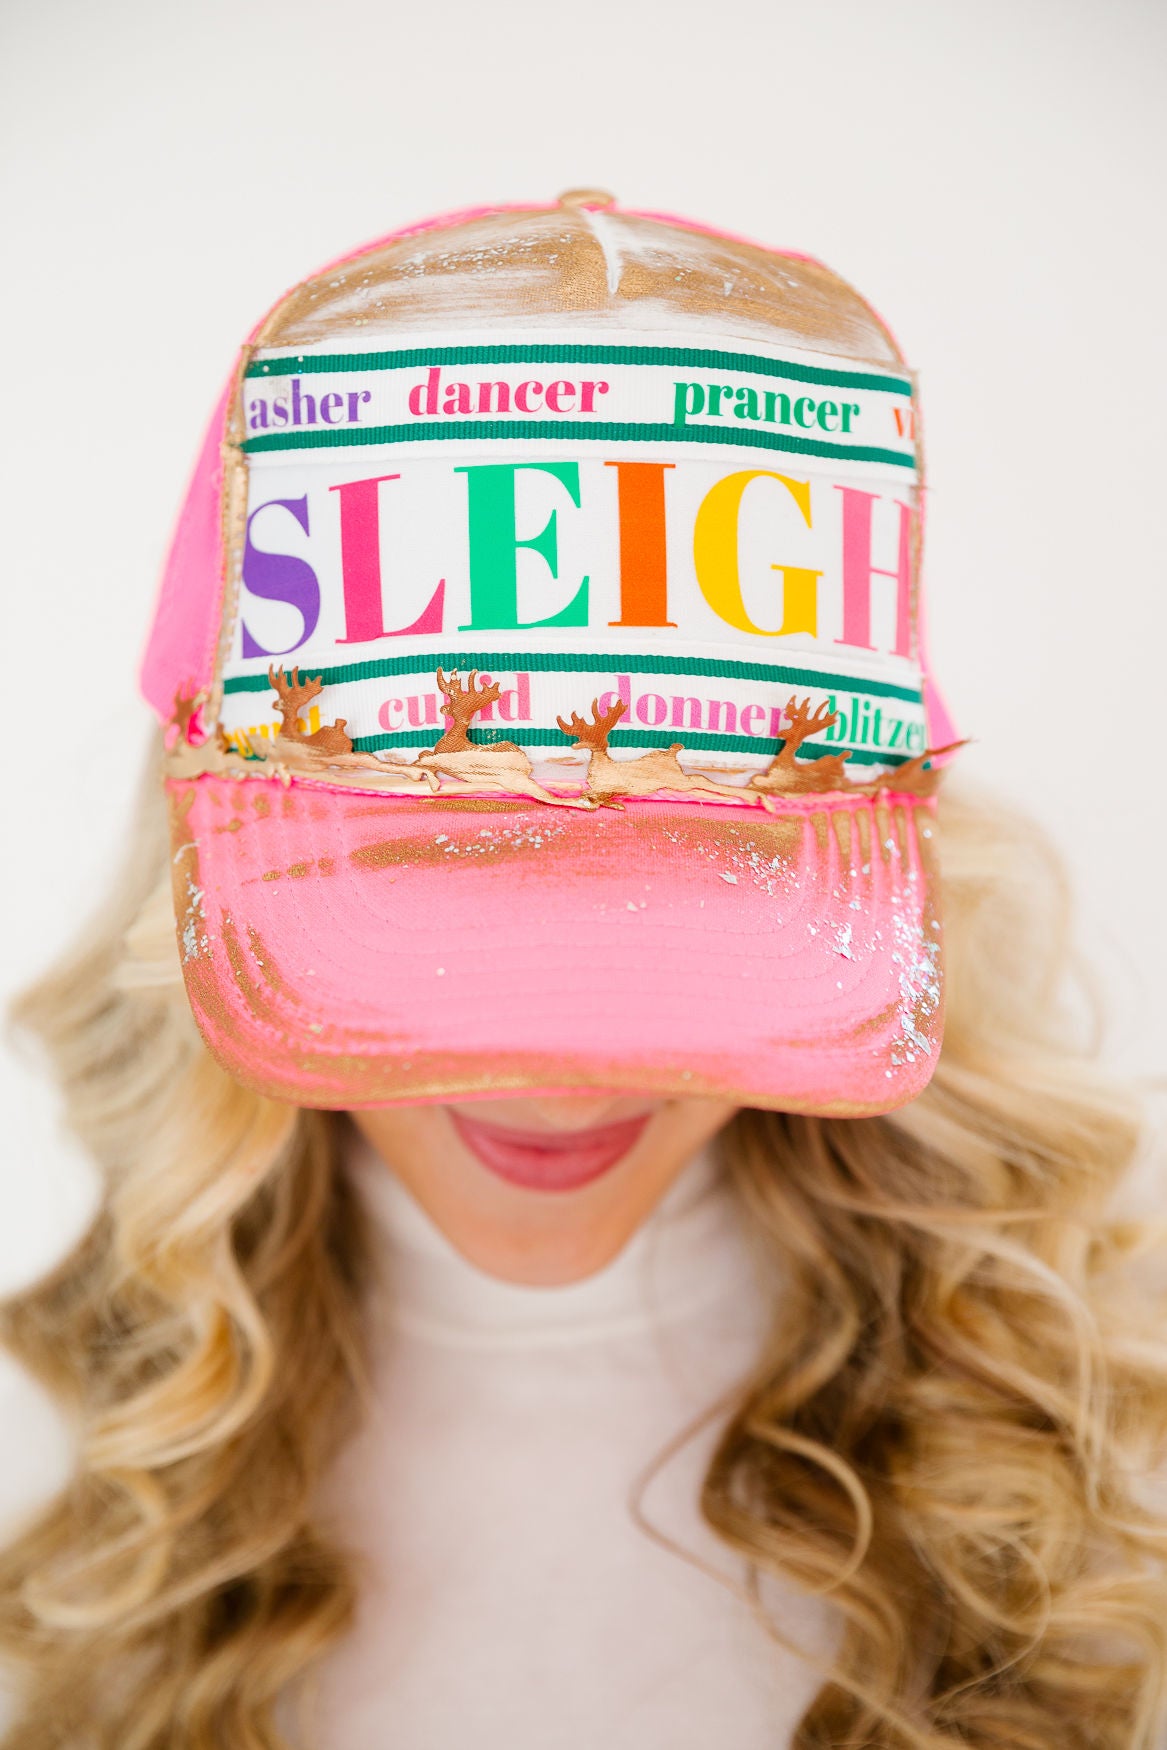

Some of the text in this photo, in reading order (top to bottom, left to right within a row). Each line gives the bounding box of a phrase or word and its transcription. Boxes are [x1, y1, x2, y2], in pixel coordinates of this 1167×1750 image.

[249, 378, 372, 430] asher
[408, 367, 610, 416] dancer
[673, 382, 861, 434] prancer
[241, 461, 917, 660] SLEIGH
[377, 672, 534, 734] cuid
